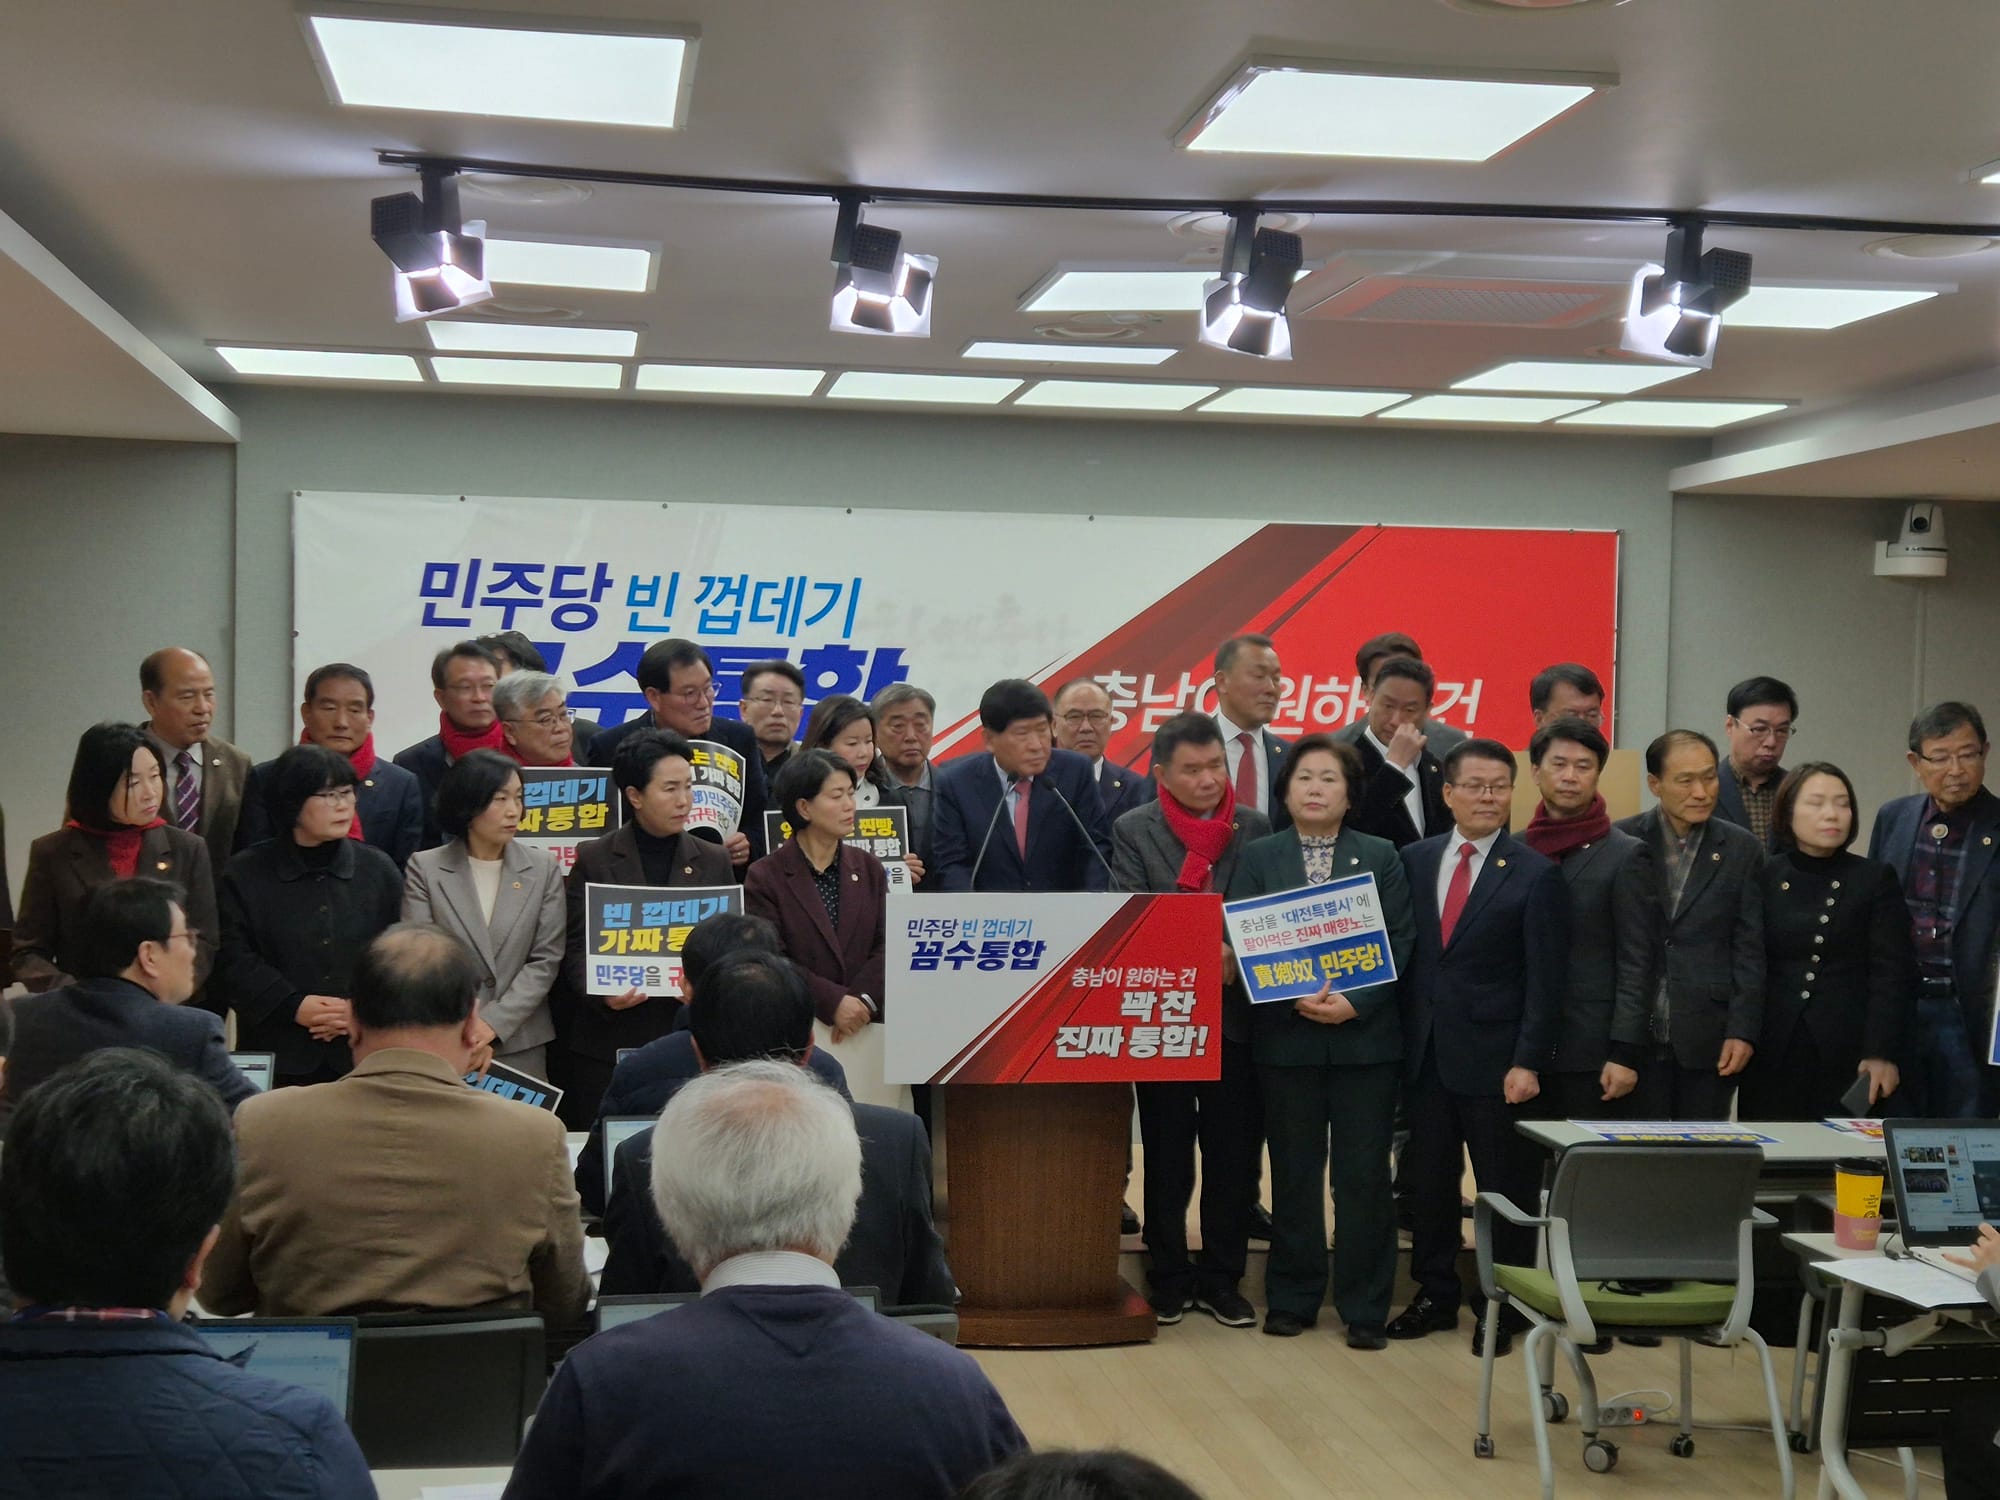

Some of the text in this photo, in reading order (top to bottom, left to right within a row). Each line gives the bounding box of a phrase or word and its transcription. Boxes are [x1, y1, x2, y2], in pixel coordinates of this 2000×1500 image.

[419, 558, 863, 639] 민주당 빈 껍데기
[1093, 669, 1483, 738] 충남 원하 건
[546, 803, 610, 832] 통합
[859, 817, 897, 838] 찐빵,
[873, 838, 902, 858] 통합
[602, 896, 729, 928] 빈 껍데기
[1240, 914, 1278, 934] 충남을
[598, 926, 695, 955] 가짜 통
[907, 918, 1033, 939] 민주당 빈 껍데기
[1243, 913, 1376, 952] 팔아먹은 진짜 매향노는
[909, 939, 1048, 972] 꼼수통합
[1319, 943, 1385, 980] 민주당!
[596, 965, 661, 987] 민주당을
[1071, 967, 1198, 988] 충남이 원하는 건
[1121, 990, 1197, 1023] 꽉 찬
[1055, 1025, 1209, 1059] 진짜 통합!
